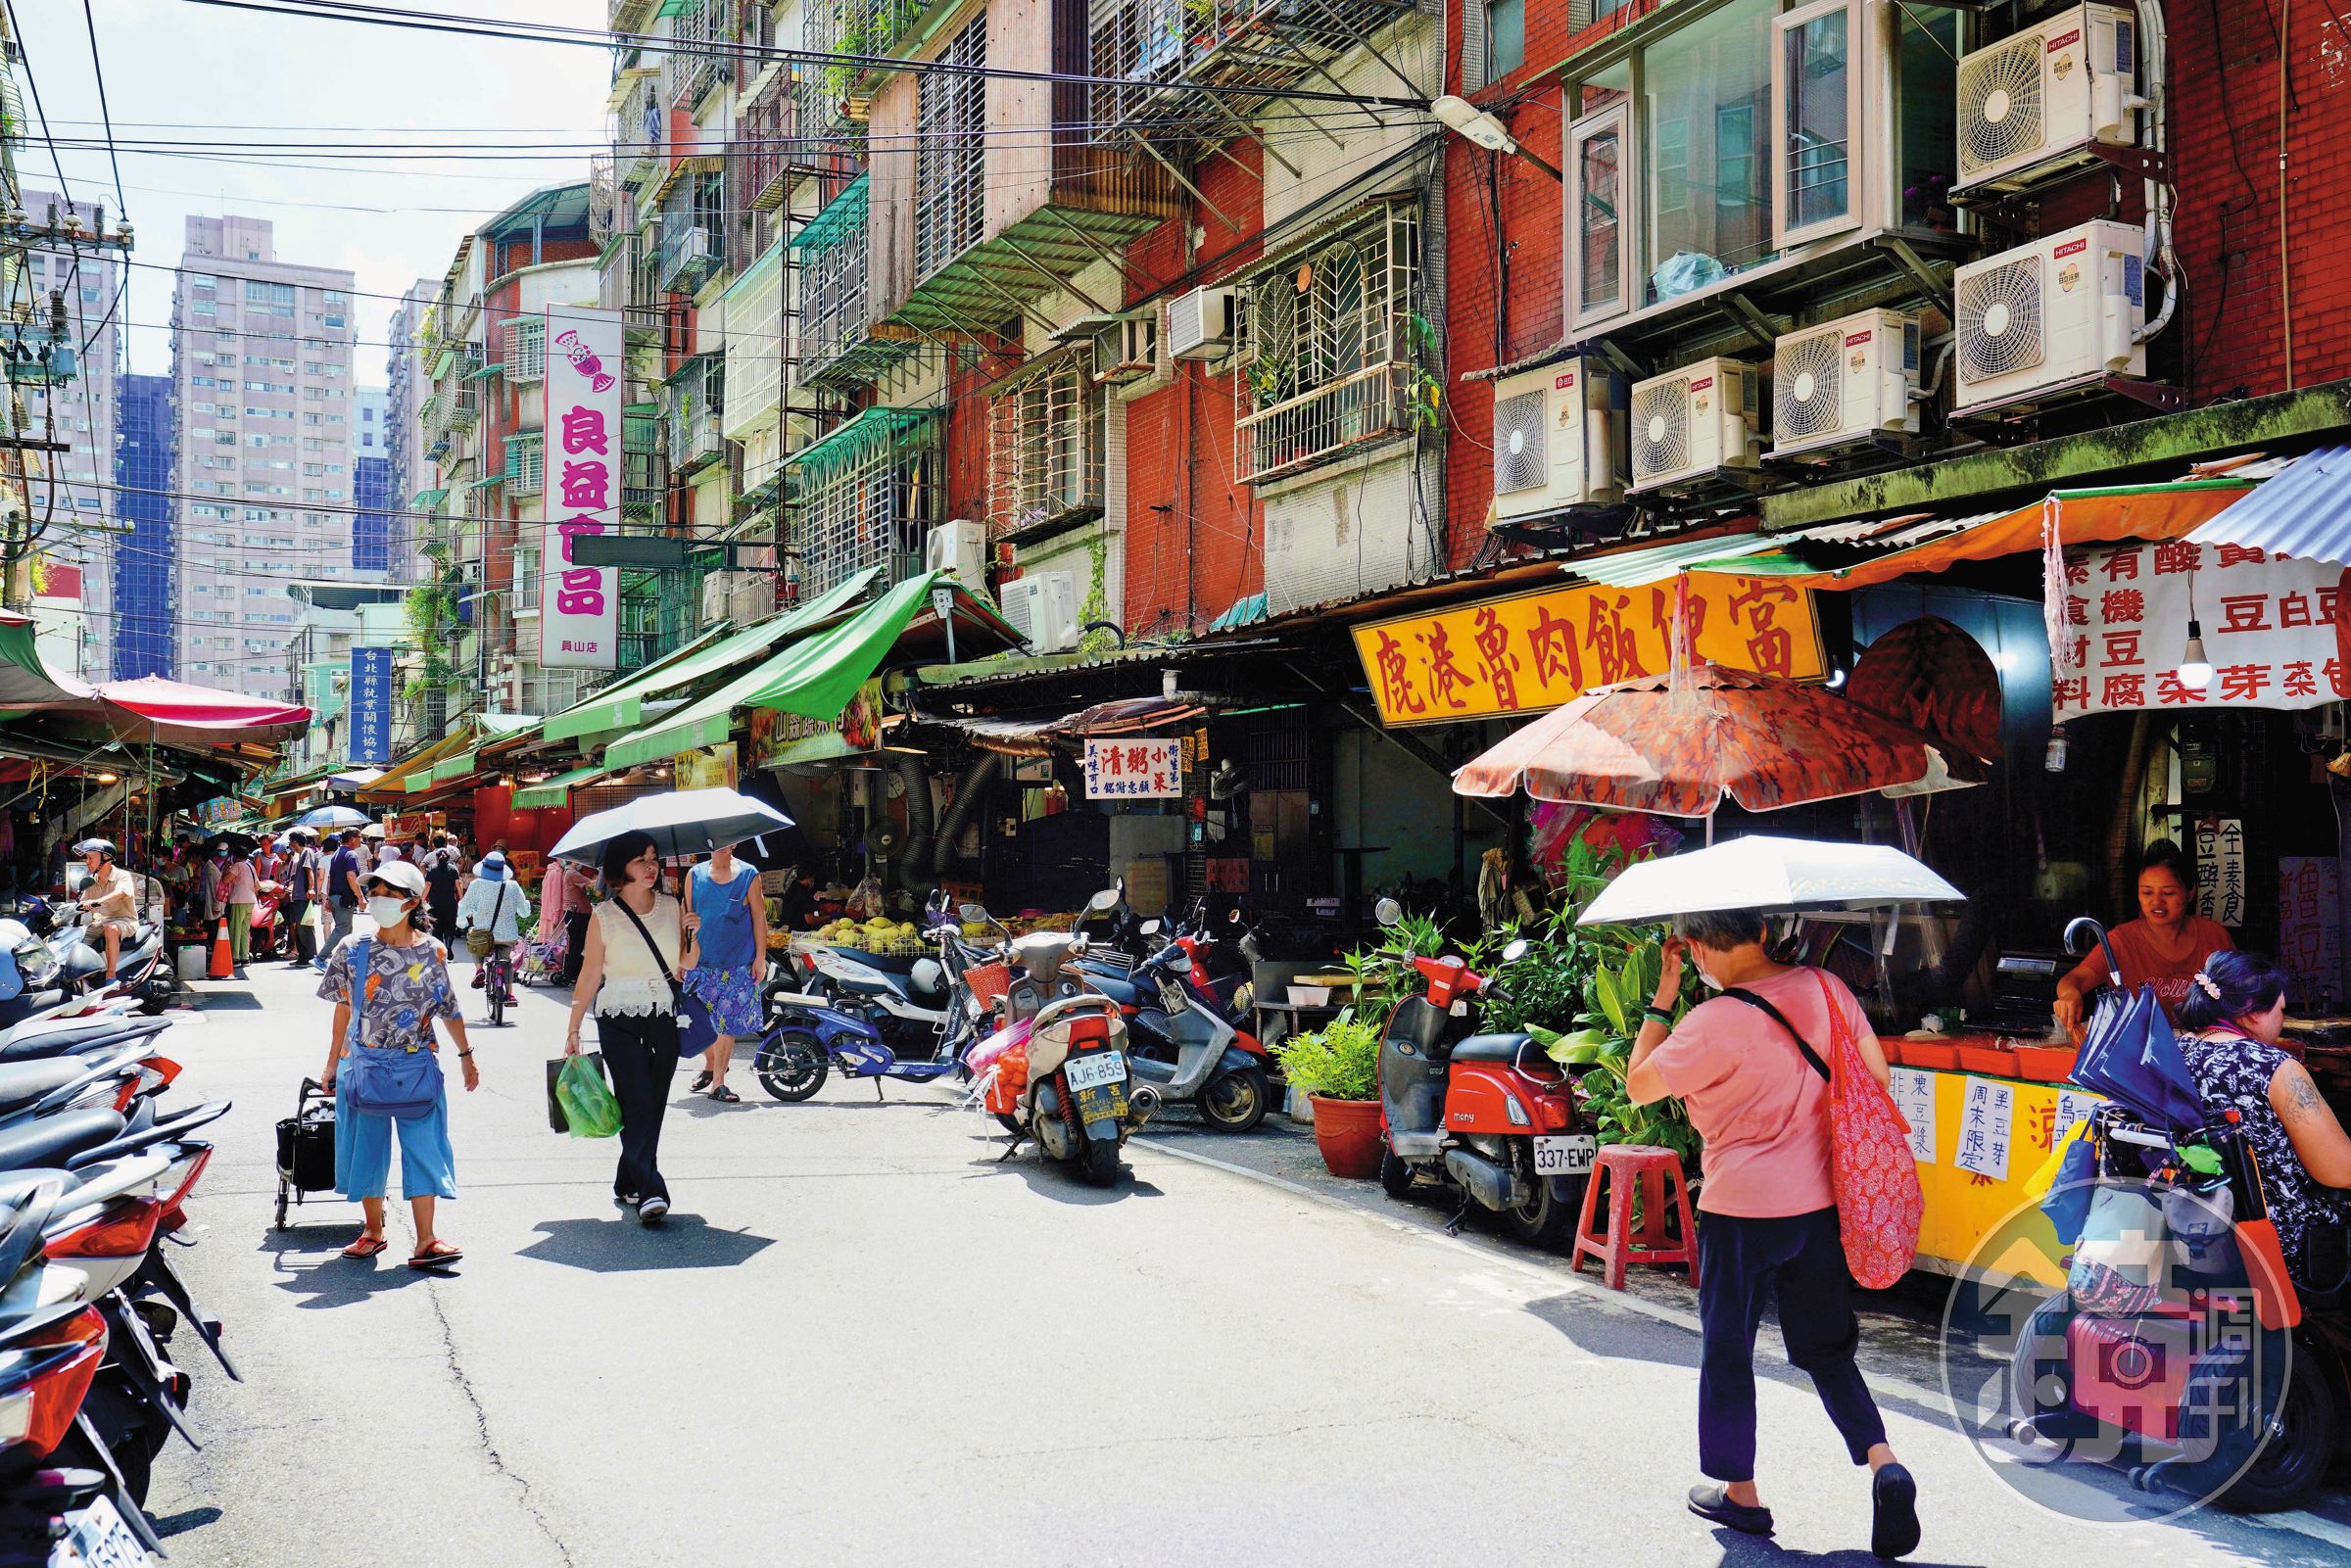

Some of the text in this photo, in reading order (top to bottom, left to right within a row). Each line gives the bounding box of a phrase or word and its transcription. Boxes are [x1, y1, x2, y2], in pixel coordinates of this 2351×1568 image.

[2048, 31, 2078, 50] HITACHI
[2055, 242, 2085, 257] HITACHI
[1847, 332, 1871, 345] HITACHI
[560, 640, 598, 652] 員山店
[2100, 546, 2145, 708] 有機豆腐
[2275, 552, 2317, 697] 白菜
[361, 650, 378, 759] 台北縣就業關懷協會
[1087, 744, 1099, 794] 美味可口
[1168, 744, 1180, 791] 衛生第一
[2220, 823, 2245, 924] 全素食
[1070, 1062, 1124, 1086] AJ6-859
[1454, 1113, 1474, 1123] many
[1961, 1085, 1988, 1171] 周末限定
[1991, 1089, 2009, 1165] 黑豆芽
